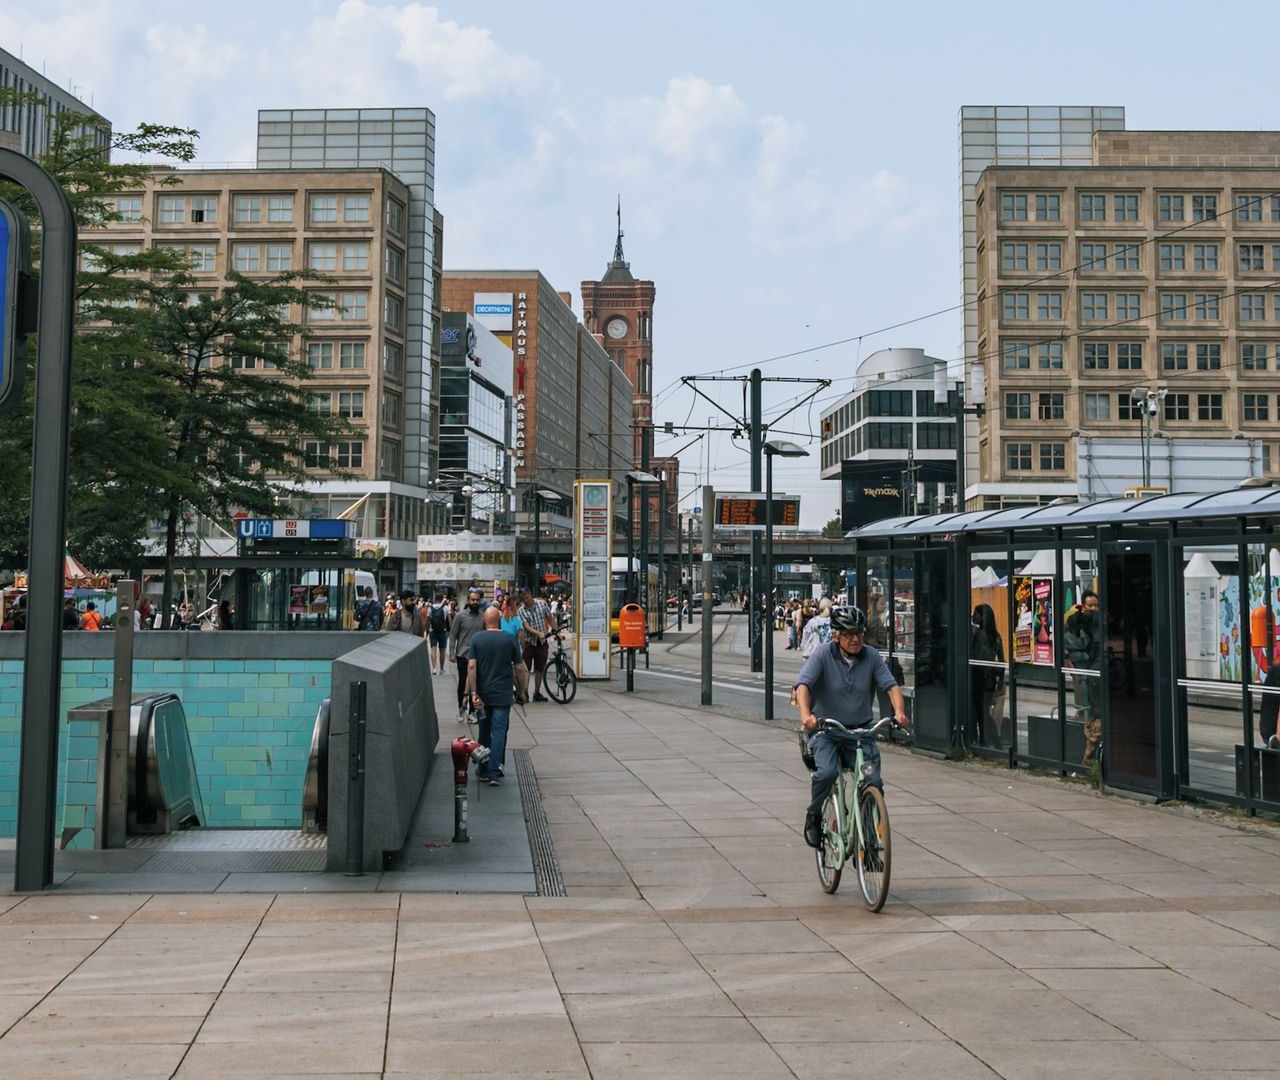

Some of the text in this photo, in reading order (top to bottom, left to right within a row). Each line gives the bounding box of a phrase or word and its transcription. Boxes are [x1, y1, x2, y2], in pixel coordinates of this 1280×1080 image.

[476, 305, 511, 313] DECATHLON
[517, 292, 526, 355] RATHAUS
[516, 394, 525, 467] PASSAGEN
[241, 520, 254, 536] U
